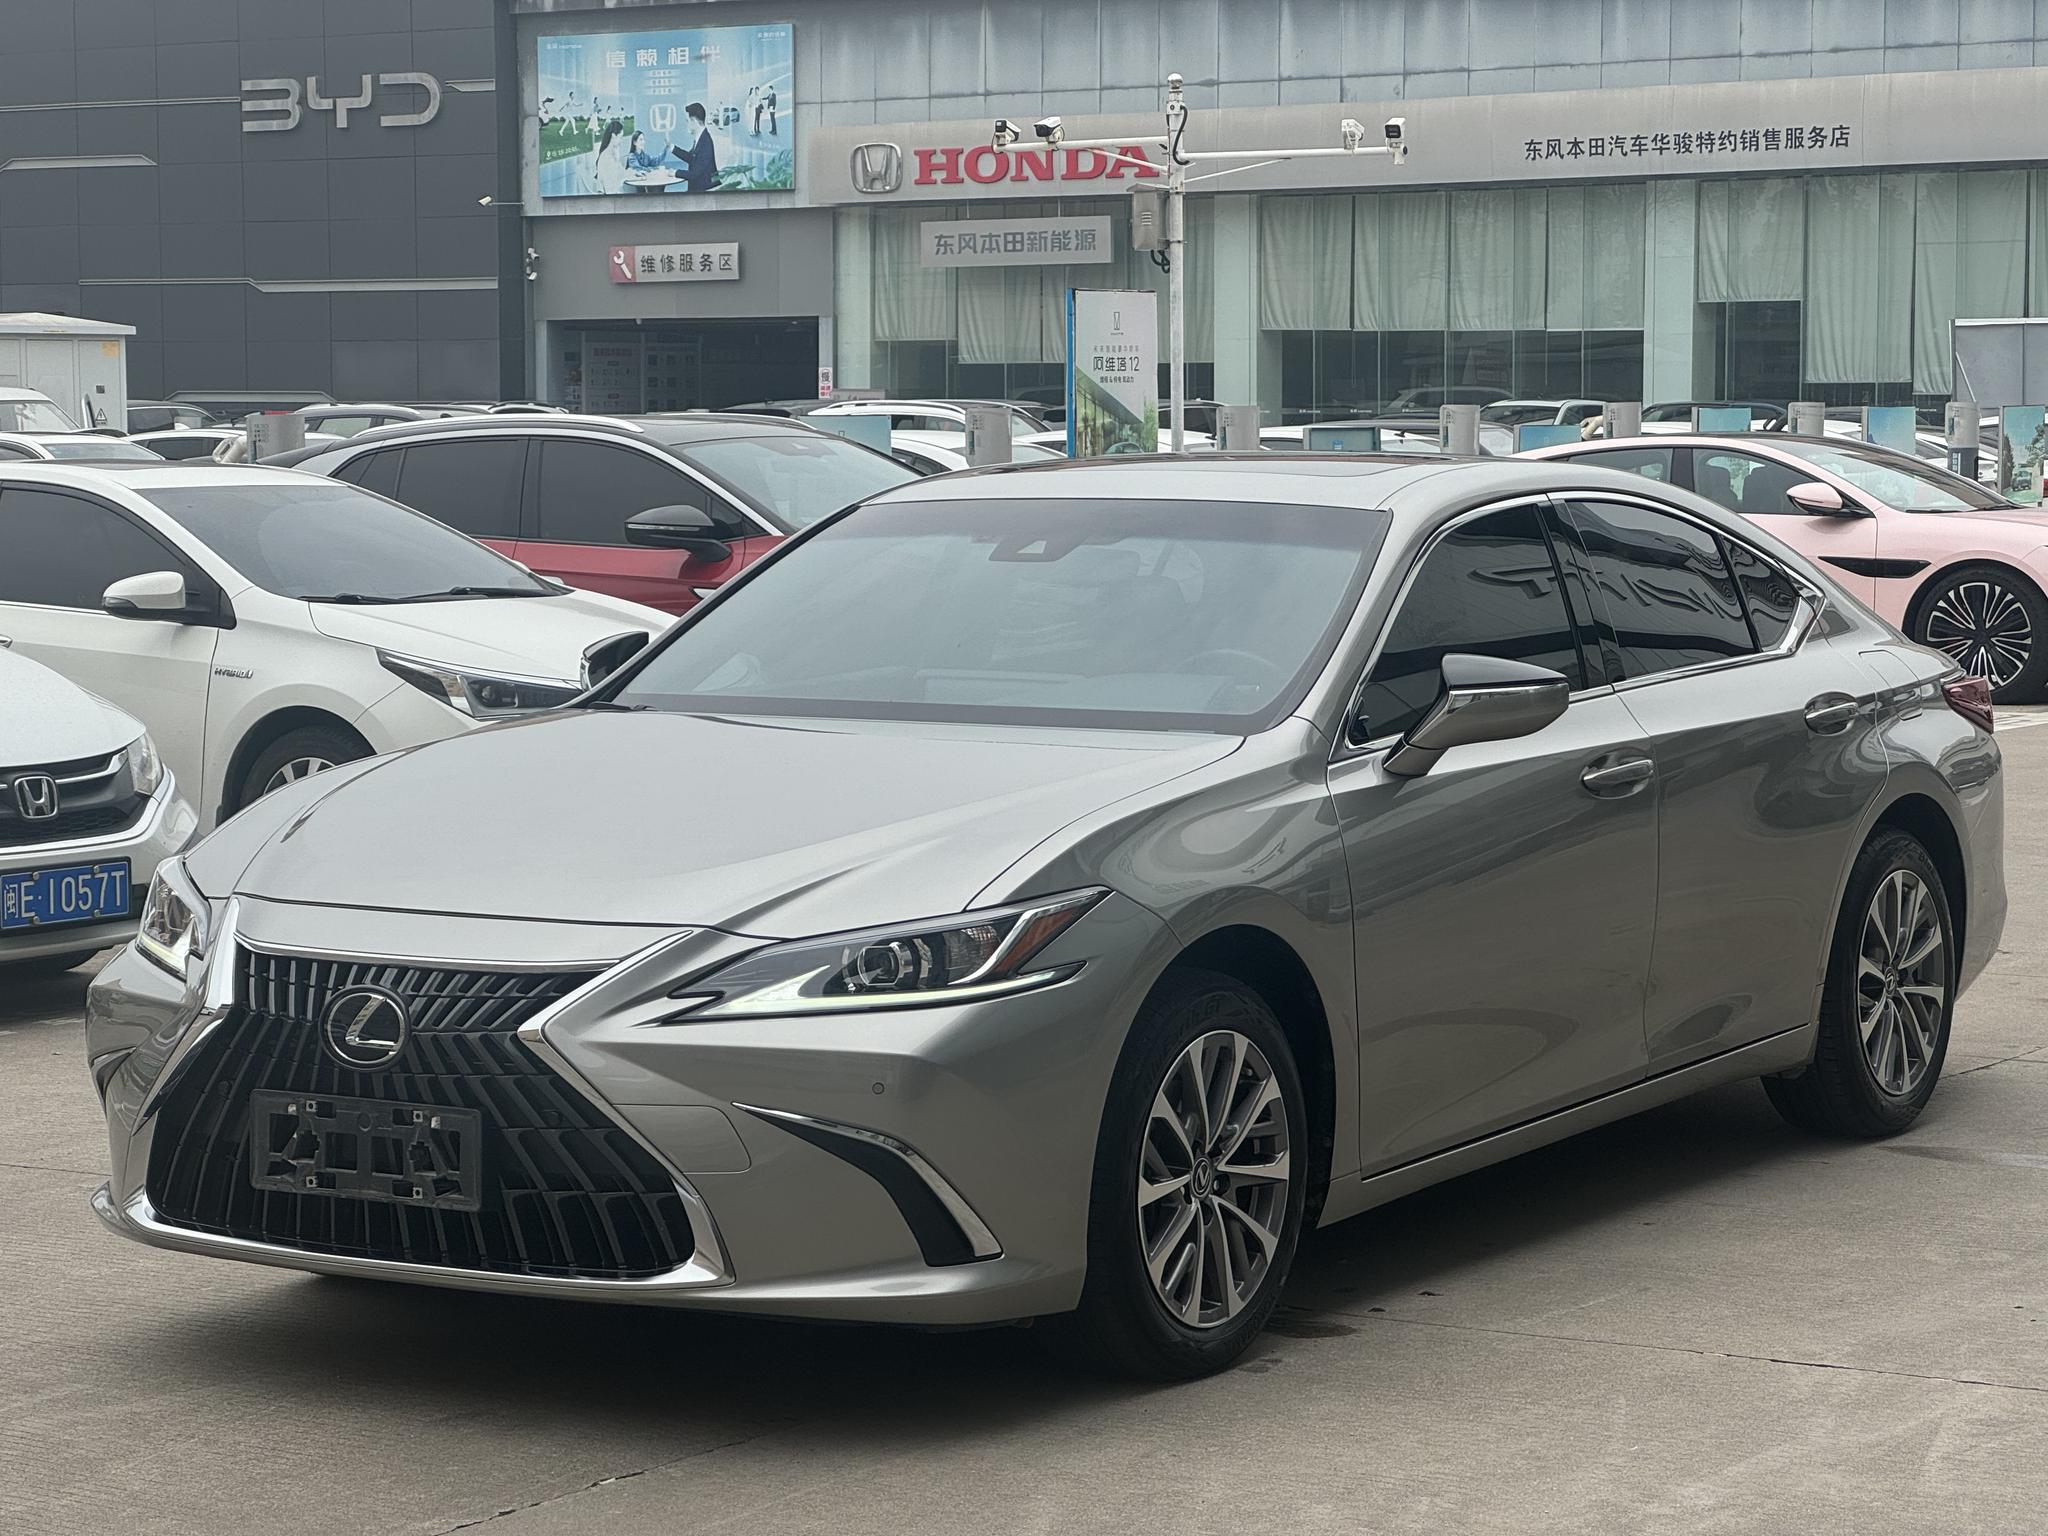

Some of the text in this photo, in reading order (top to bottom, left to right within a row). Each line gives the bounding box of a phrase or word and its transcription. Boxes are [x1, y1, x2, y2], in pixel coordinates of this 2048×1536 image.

[606, 45, 721, 68] 信赖相伴
[241, 72, 441, 132] BYD
[1524, 124, 1851, 161] 东风本田汽车华骏特约销售服务店
[913, 145, 1160, 185] HONDA
[934, 228, 1097, 256] 东风本田新能源
[640, 253, 733, 273] 维修服务区
